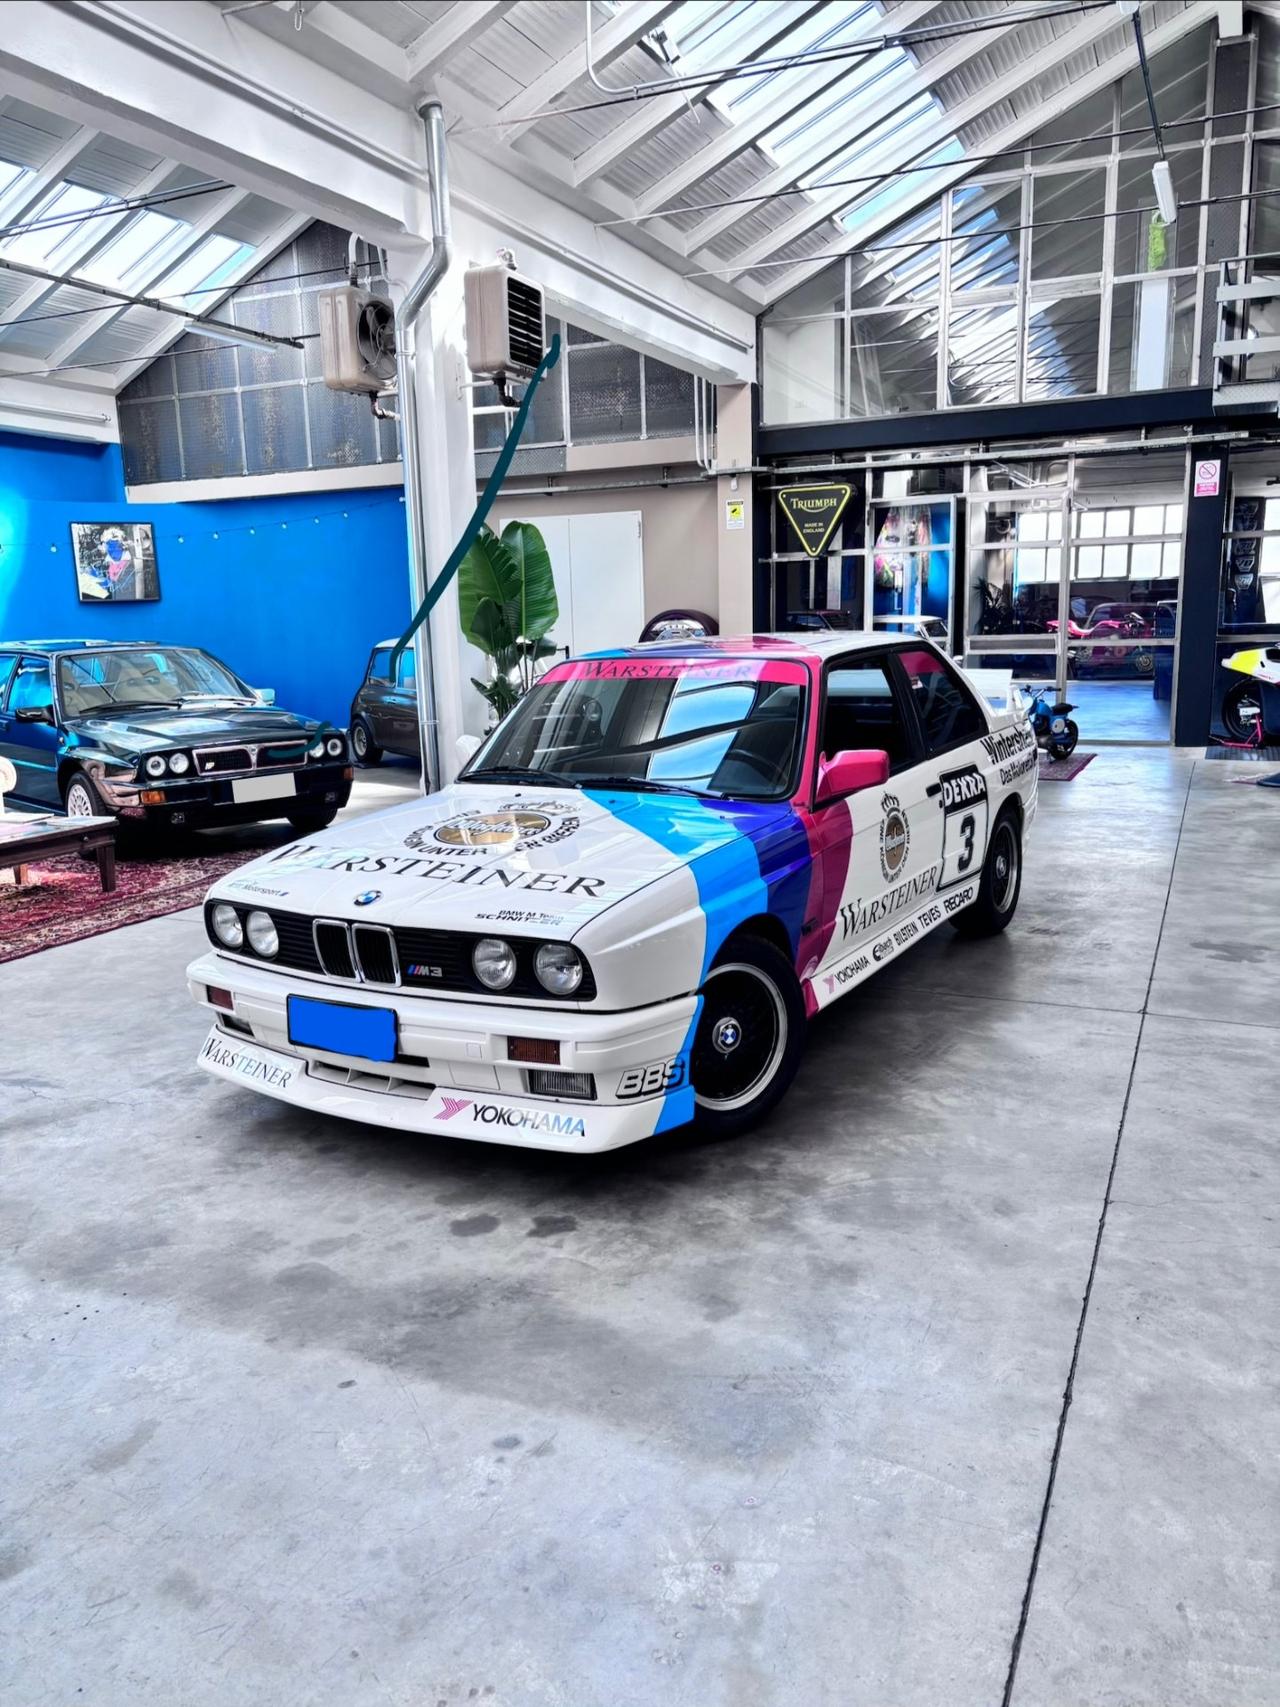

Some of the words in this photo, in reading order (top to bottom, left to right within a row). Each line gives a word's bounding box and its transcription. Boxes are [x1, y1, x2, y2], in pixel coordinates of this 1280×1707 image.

[790, 498, 837, 509] TRIUMPH
[942, 772, 986, 807] DEKRA
[418, 845, 488, 856] UNTER
[958, 813, 976, 873] 3
[499, 910, 525, 918] BMW
[840, 866, 937, 941] WARSTEINER
[834, 955, 871, 985] YOKOHAMA
[893, 920, 919, 946] BILSTEIN
[918, 905, 942, 929] TEVES
[943, 886, 974, 914] RECARO
[417, 964, 443, 977] M3
[201, 1037, 292, 1088] WARSTEINER
[615, 1056, 685, 1099] BBS
[473, 1103, 586, 1137] YOKOHAMA
